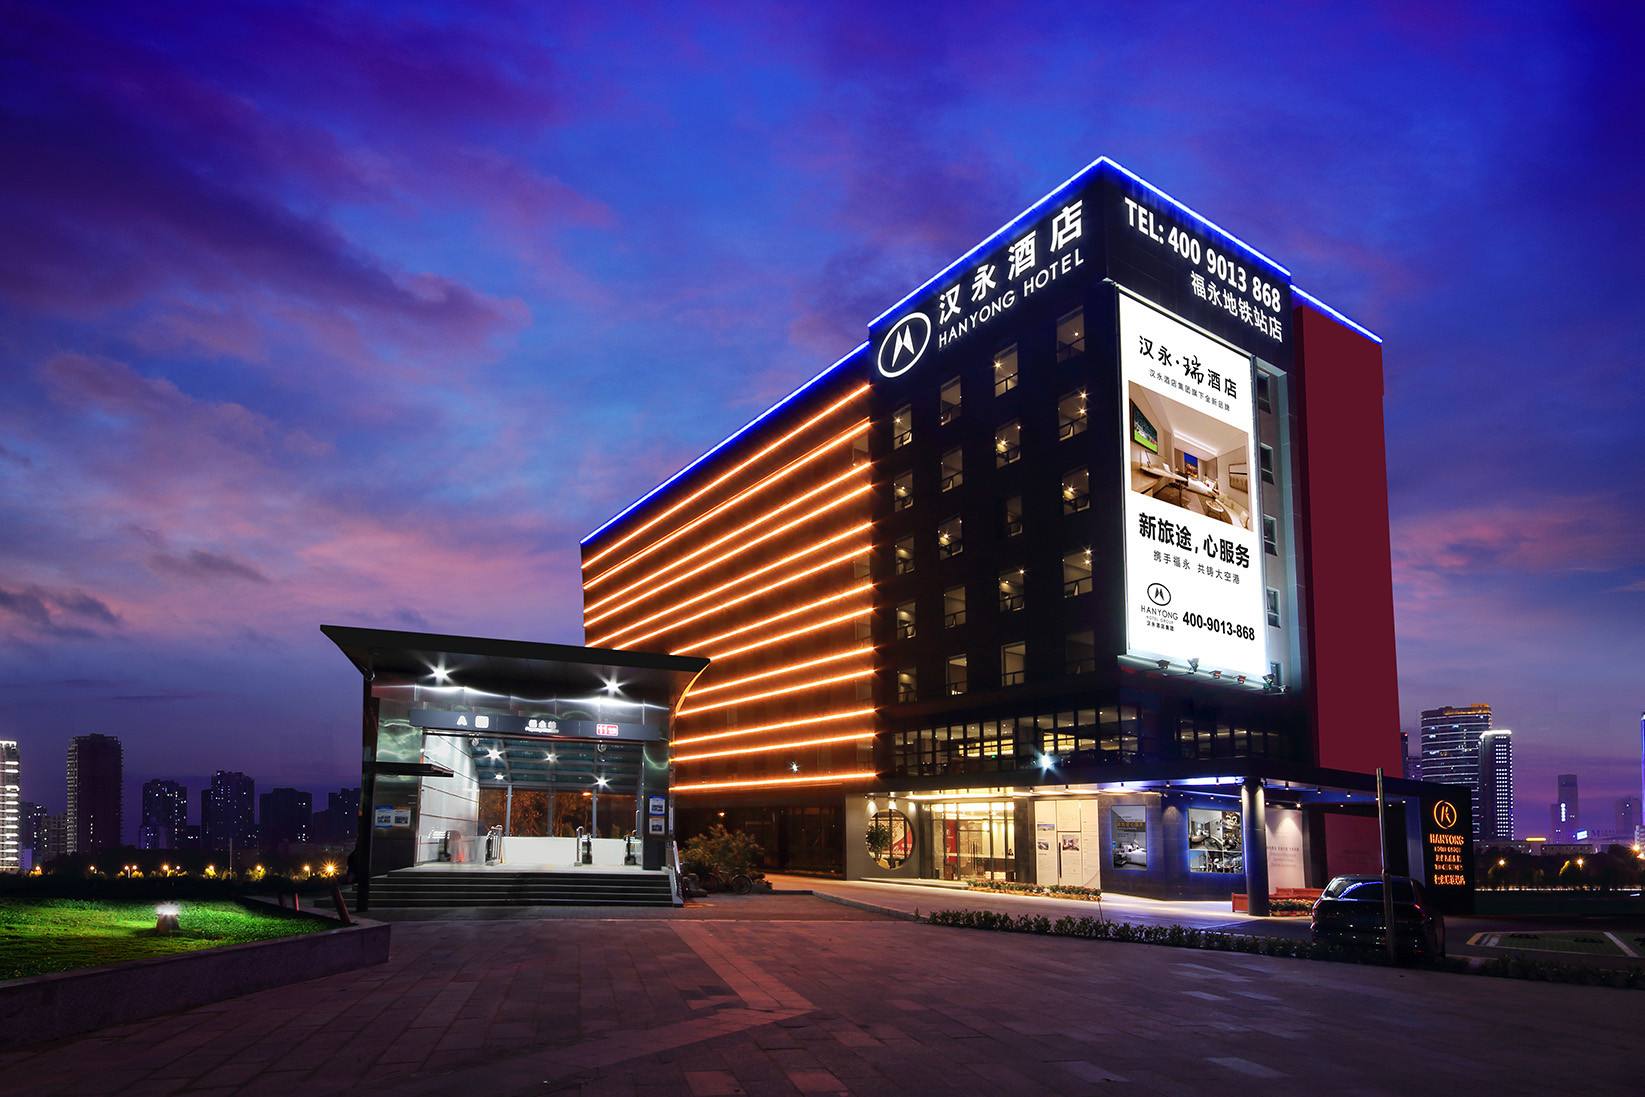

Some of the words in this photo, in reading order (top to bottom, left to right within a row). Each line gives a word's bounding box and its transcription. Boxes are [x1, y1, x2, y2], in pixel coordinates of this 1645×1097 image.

[939, 200, 1083, 325] 汉永酒店
[1124, 197, 1164, 244] TEL:
[1168, 227, 1201, 265] 400
[1206, 248, 1247, 292] 9013
[1252, 276, 1281, 312] 868
[939, 290, 1016, 348] HANYONG
[1023, 248, 1084, 297] HOTEL
[1190, 270, 1283, 343] 福永地铁站店
[1141, 605, 1179, 620] HANYONG
[1182, 611, 1255, 641] 400-9013-868
[456, 715, 468, 726] A
